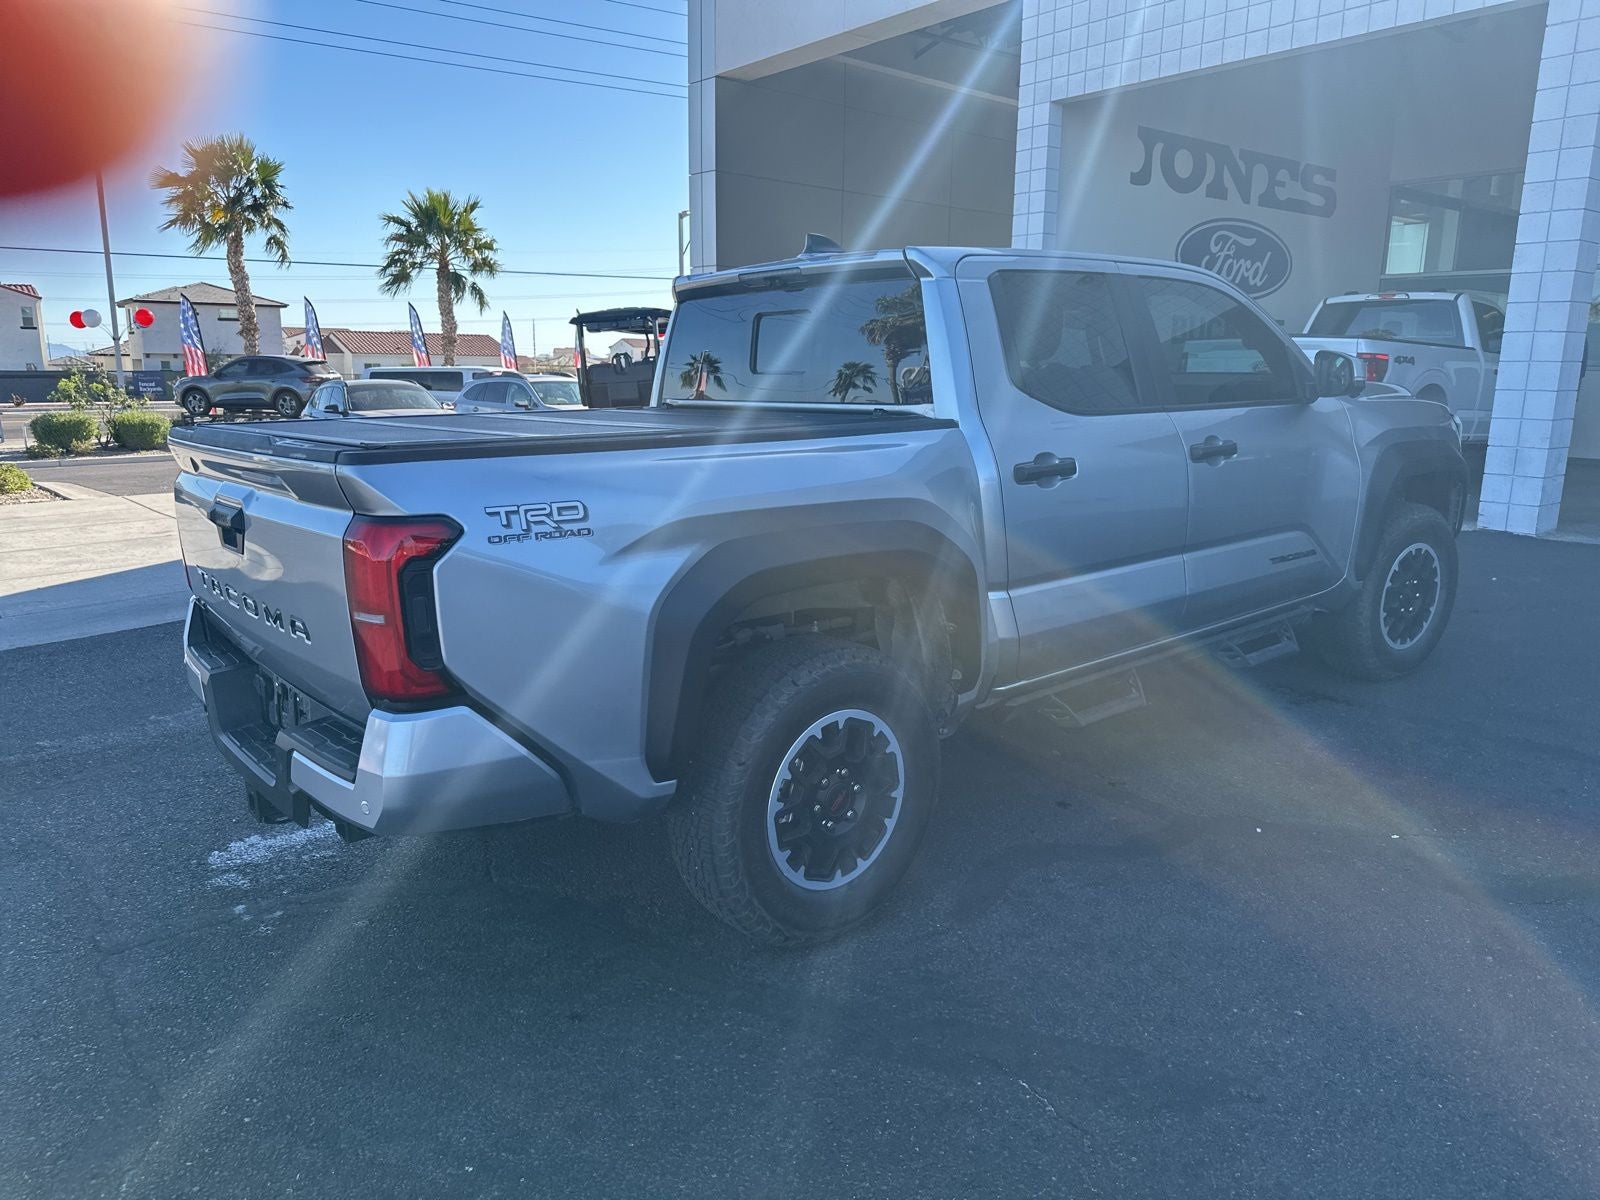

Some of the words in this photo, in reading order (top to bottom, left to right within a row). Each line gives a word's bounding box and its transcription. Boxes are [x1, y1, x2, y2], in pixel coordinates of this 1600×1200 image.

[1129, 124, 1338, 219] JONES
[1202, 230, 1274, 288] Ford
[484, 500, 589, 533] TRD
[487, 532, 532, 545] OFF
[534, 527, 594, 542] ROAD
[196, 564, 312, 645] TACOMA
